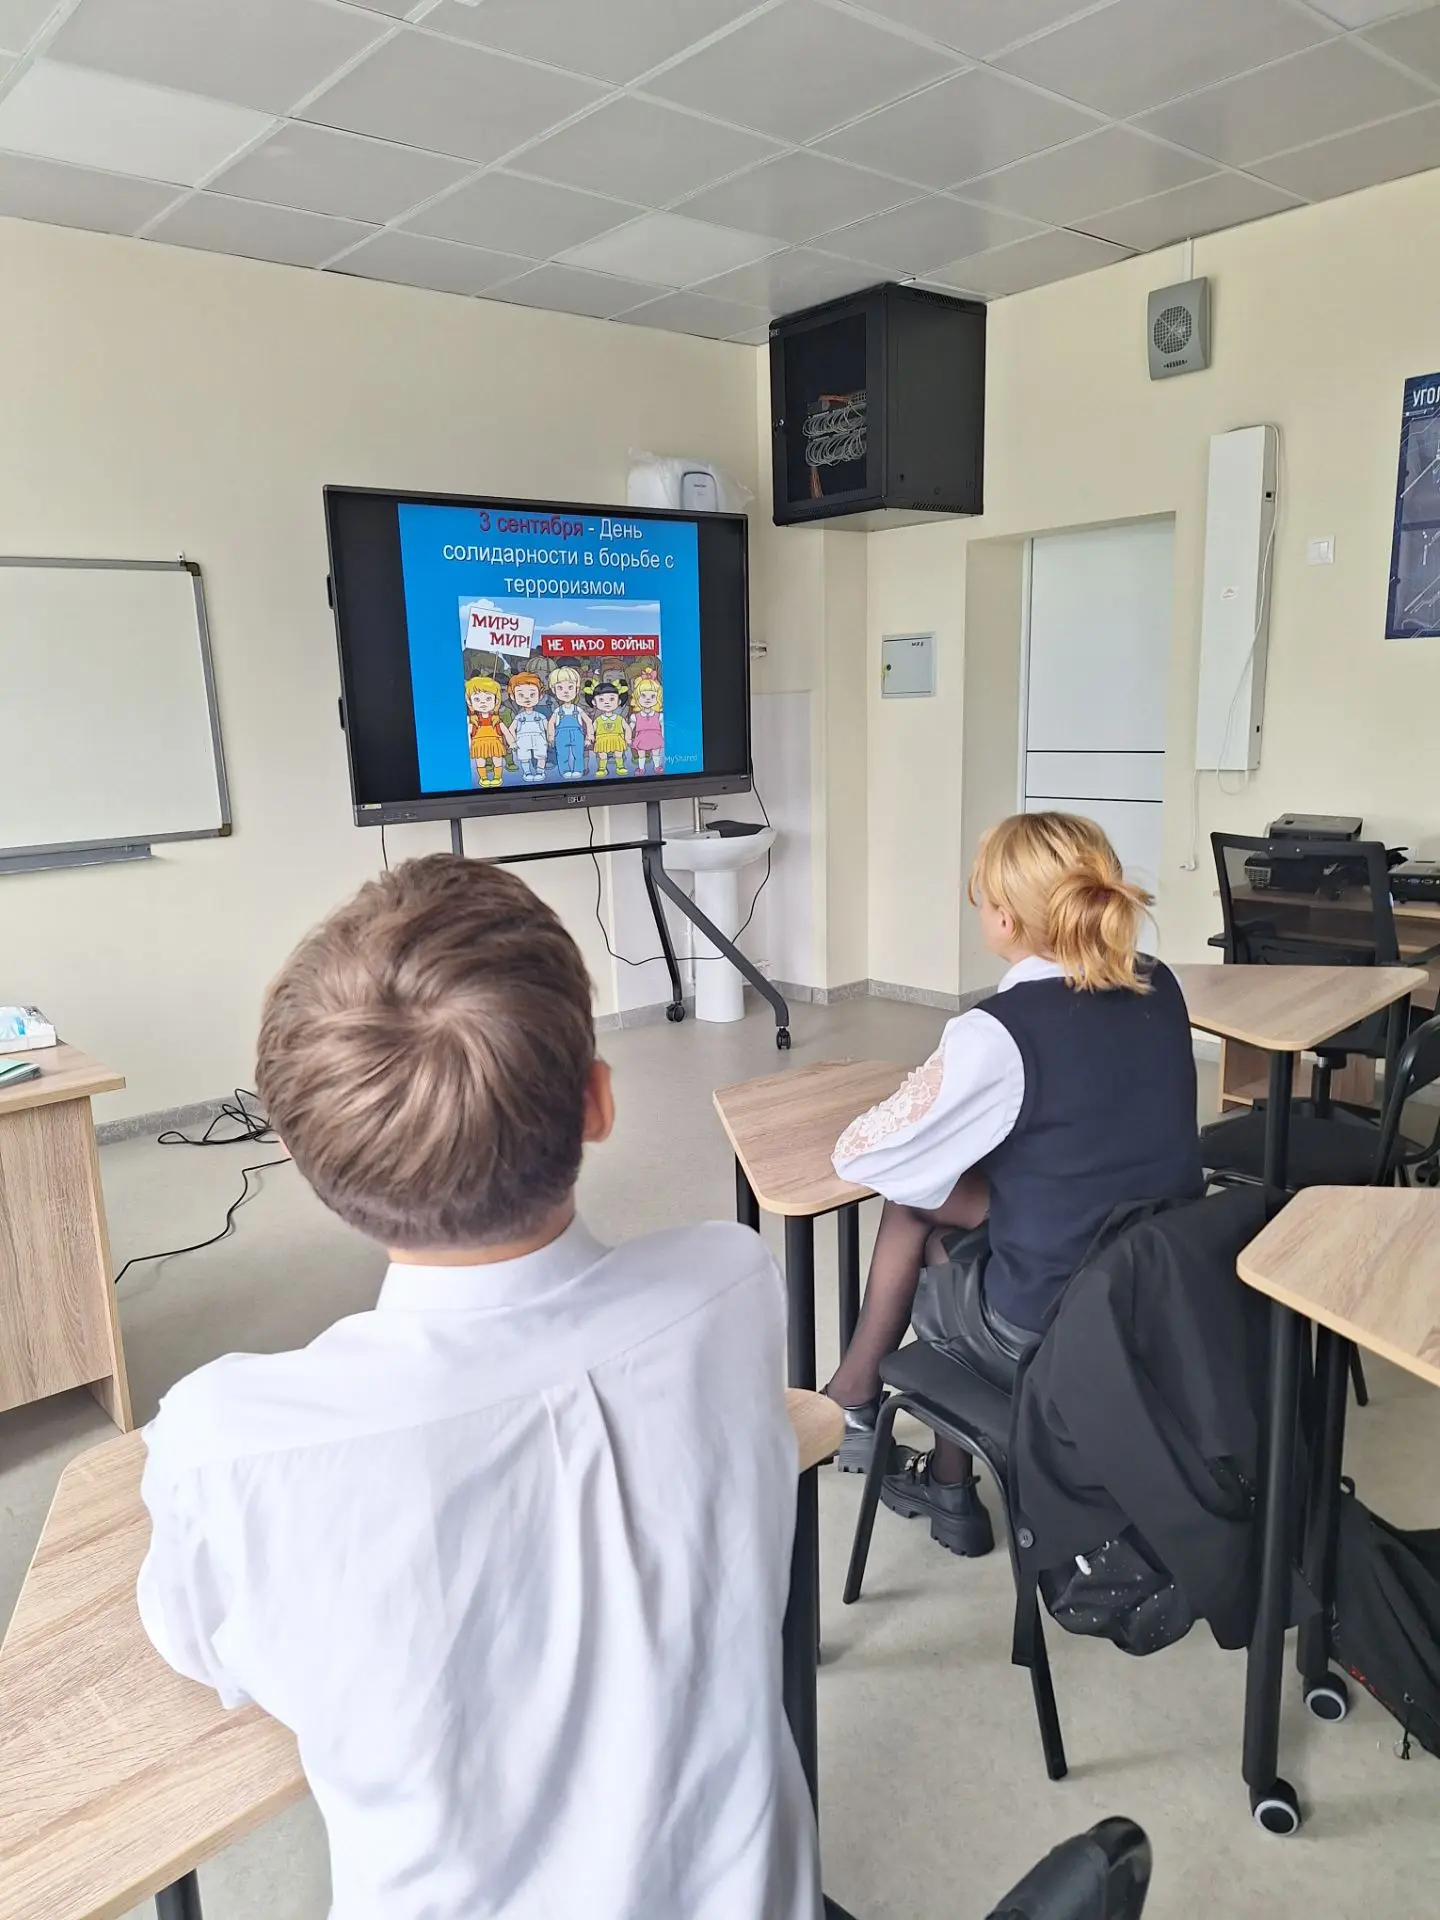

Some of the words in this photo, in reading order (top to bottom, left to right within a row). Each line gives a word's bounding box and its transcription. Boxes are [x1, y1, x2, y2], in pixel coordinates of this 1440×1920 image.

[480, 512, 490, 532] 3
[497, 515, 583, 540] сентября
[599, 518, 643, 540] День
[443, 544, 578, 565] солидарности
[584, 554, 594, 565] в
[600, 547, 660, 571] борьбе
[665, 556, 674, 569] с
[504, 577, 625, 598] терроризмом
[471, 613, 519, 631] МИРУ
[490, 631, 530, 649] МИР!
[547, 639, 564, 651] НЕ
[572, 639, 604, 651] НАДО
